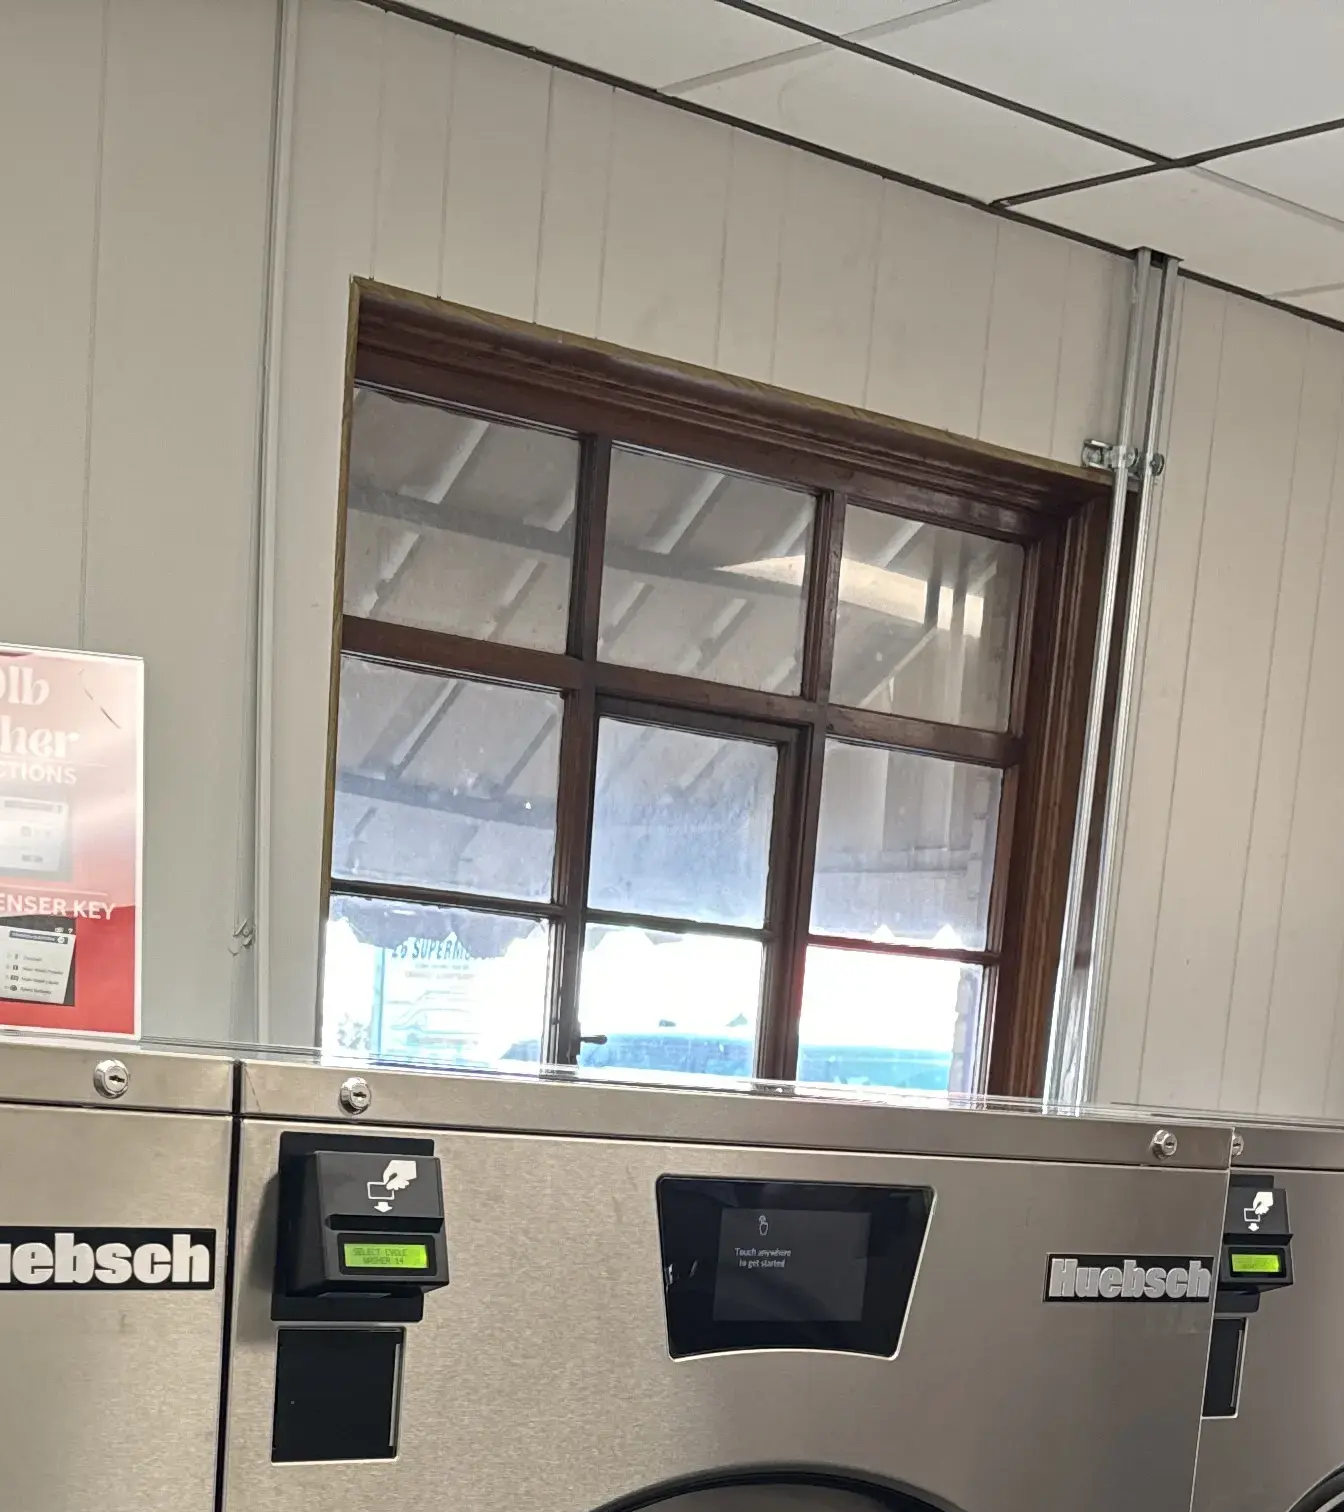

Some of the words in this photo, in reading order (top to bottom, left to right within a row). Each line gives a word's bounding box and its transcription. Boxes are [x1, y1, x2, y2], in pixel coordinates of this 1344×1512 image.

[73, 899, 116, 920] KEY
[734, 1247, 756, 1257] Touch
[1048, 1258, 1212, 1299] Huebsch
